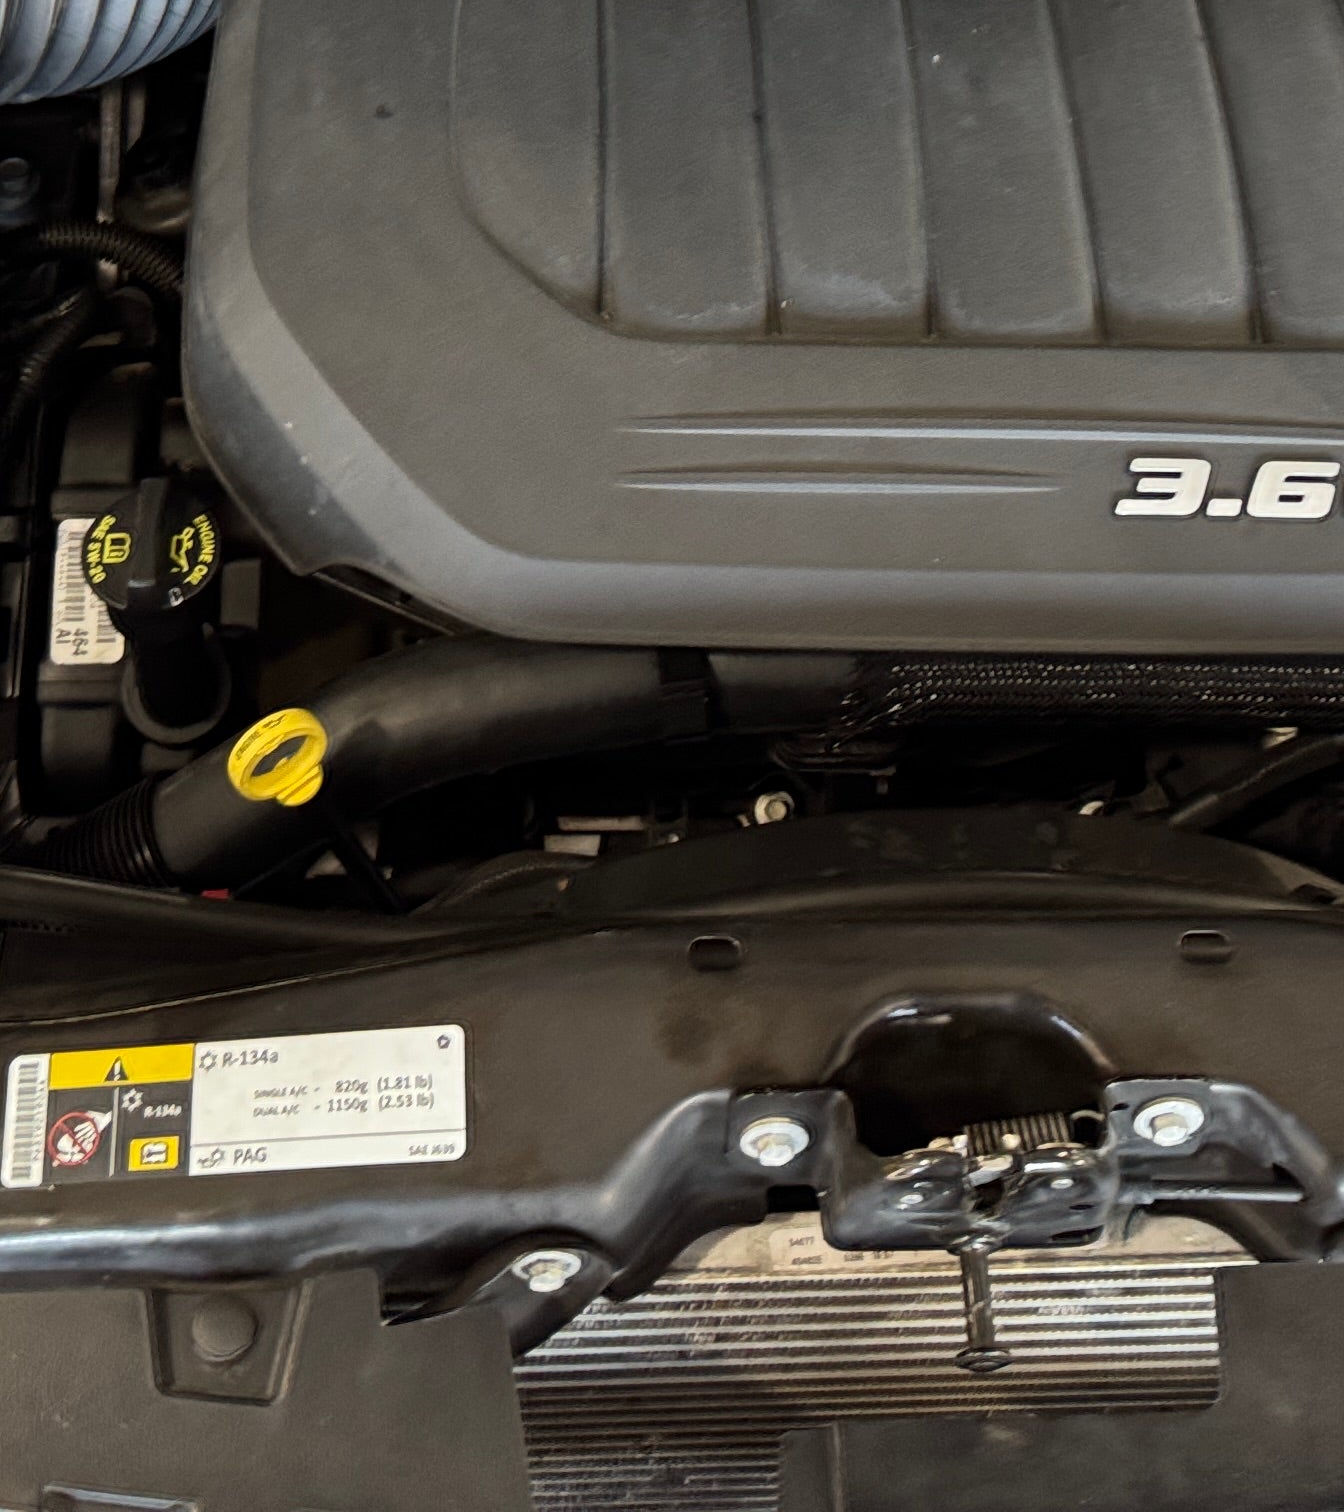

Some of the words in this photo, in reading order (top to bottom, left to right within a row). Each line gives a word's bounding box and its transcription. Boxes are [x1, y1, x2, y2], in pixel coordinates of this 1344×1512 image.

[192, 513, 216, 564] ENGINE
[222, 1049, 279, 1069] R-134a
[334, 1078, 369, 1095] 820g
[326, 1097, 369, 1114] 1150g
[232, 1146, 268, 1165] PAG
